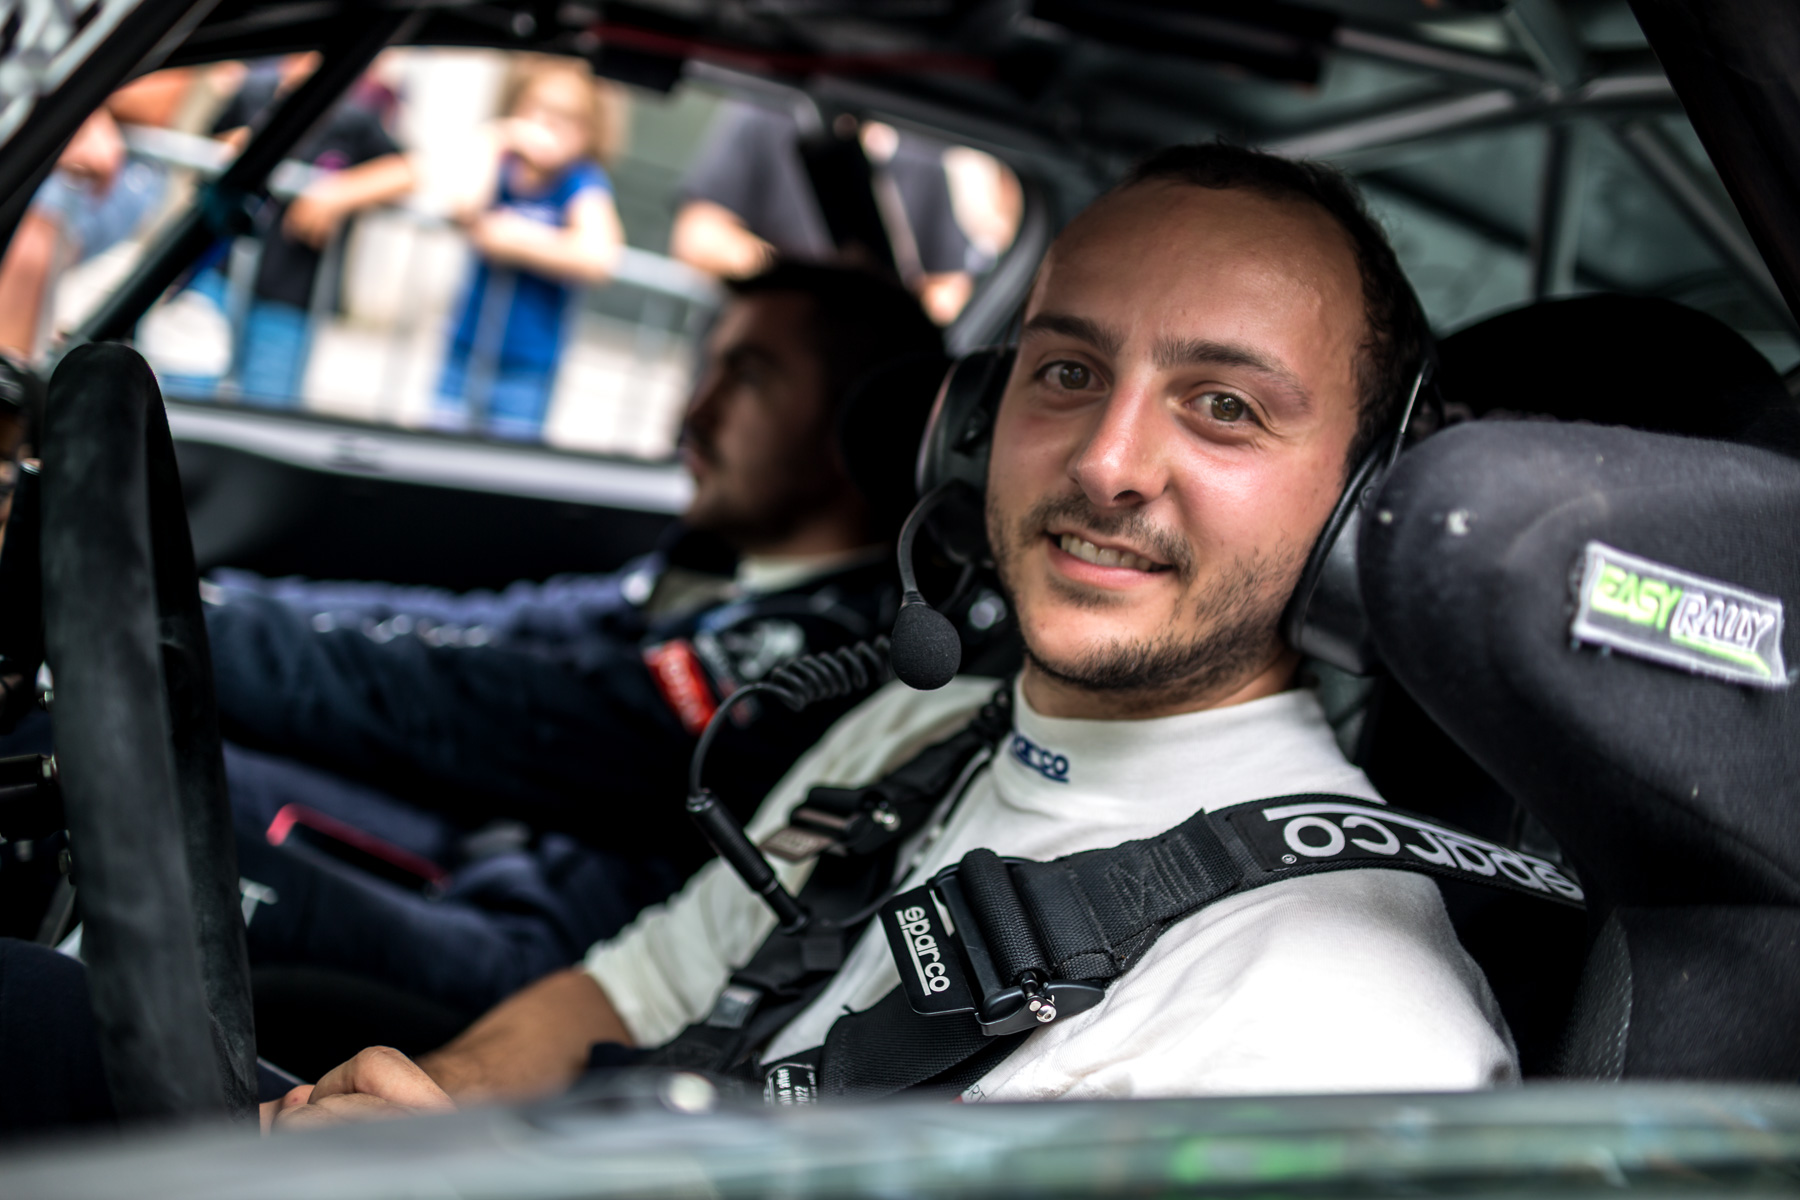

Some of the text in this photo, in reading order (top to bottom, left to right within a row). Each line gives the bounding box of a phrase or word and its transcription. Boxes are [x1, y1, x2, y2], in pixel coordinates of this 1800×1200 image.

[1591, 562, 1775, 654] EASY RALLY
[1013, 735, 1070, 782] arco
[1282, 813, 1584, 900] sparco
[902, 906, 950, 992] sparco
